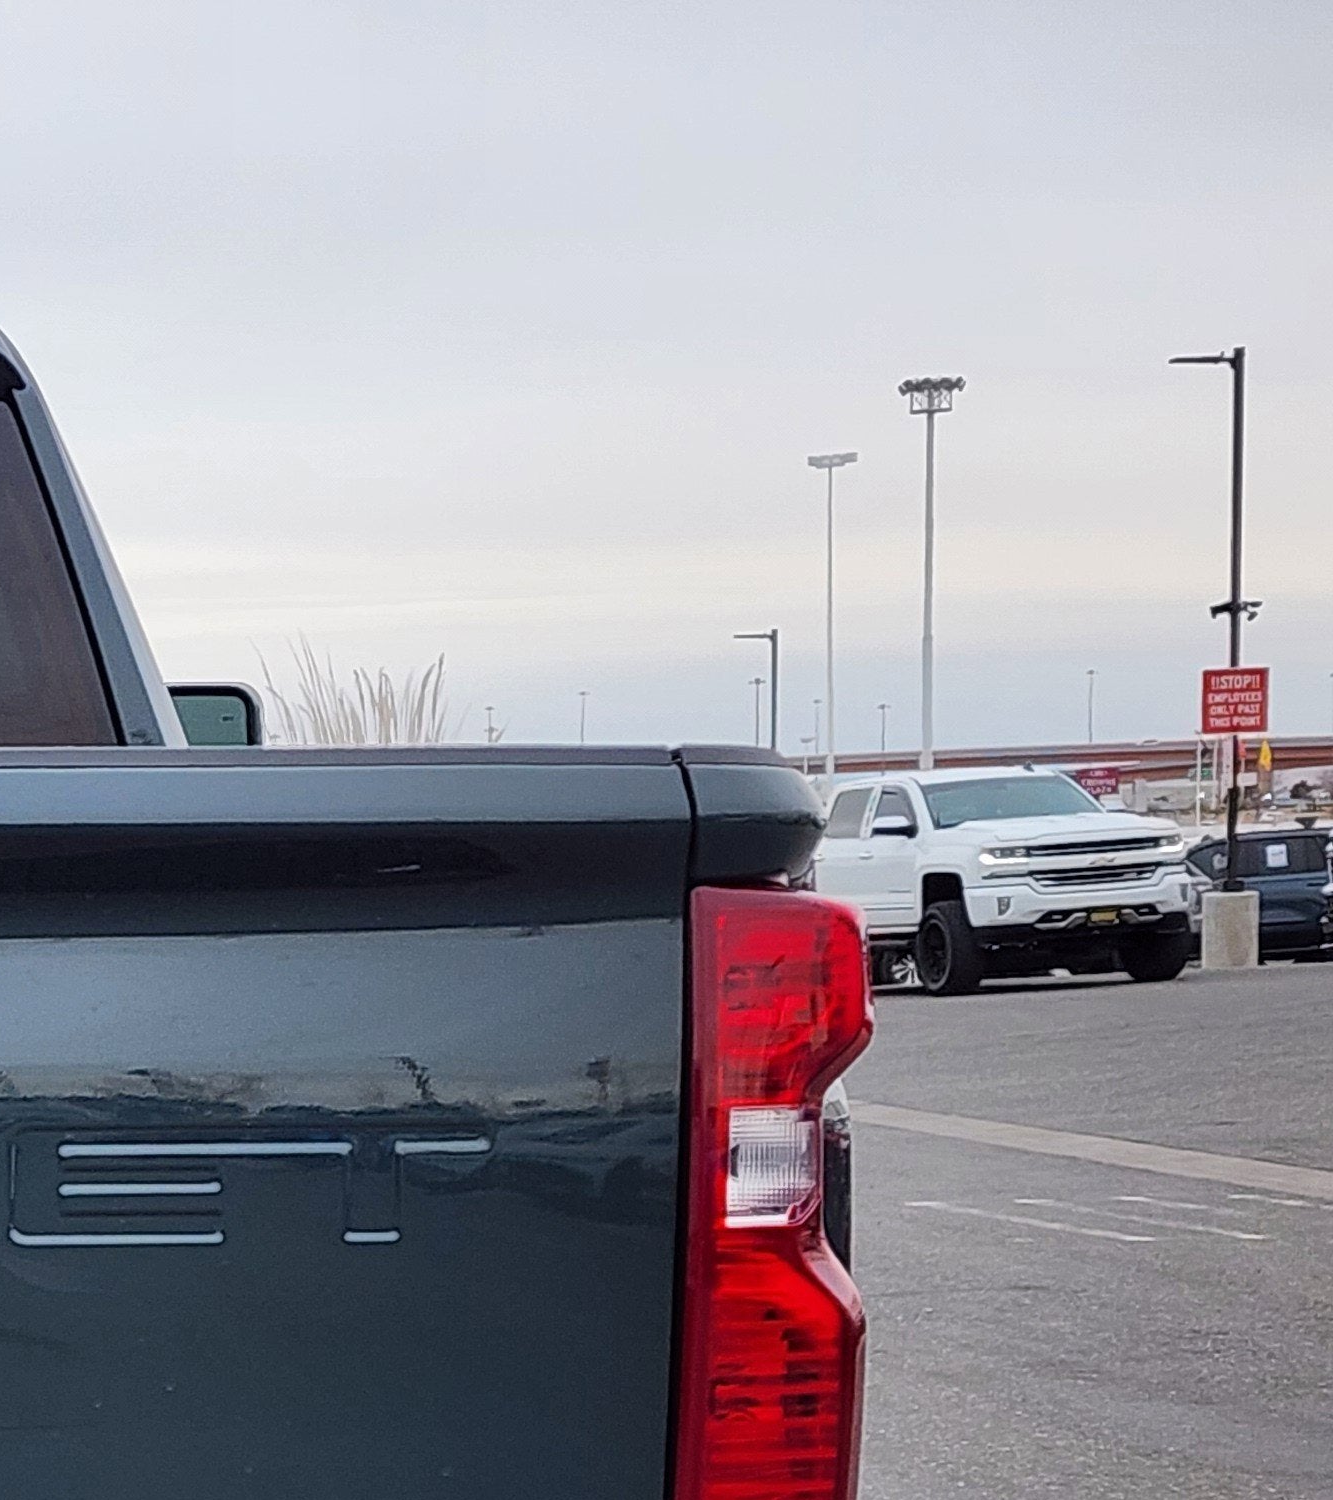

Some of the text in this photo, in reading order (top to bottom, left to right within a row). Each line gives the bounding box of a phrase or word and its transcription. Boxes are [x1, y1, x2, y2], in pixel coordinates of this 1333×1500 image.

[1209, 703, 1261, 715] ONLY PAST
[1209, 715, 1261, 727] THIS POINT
